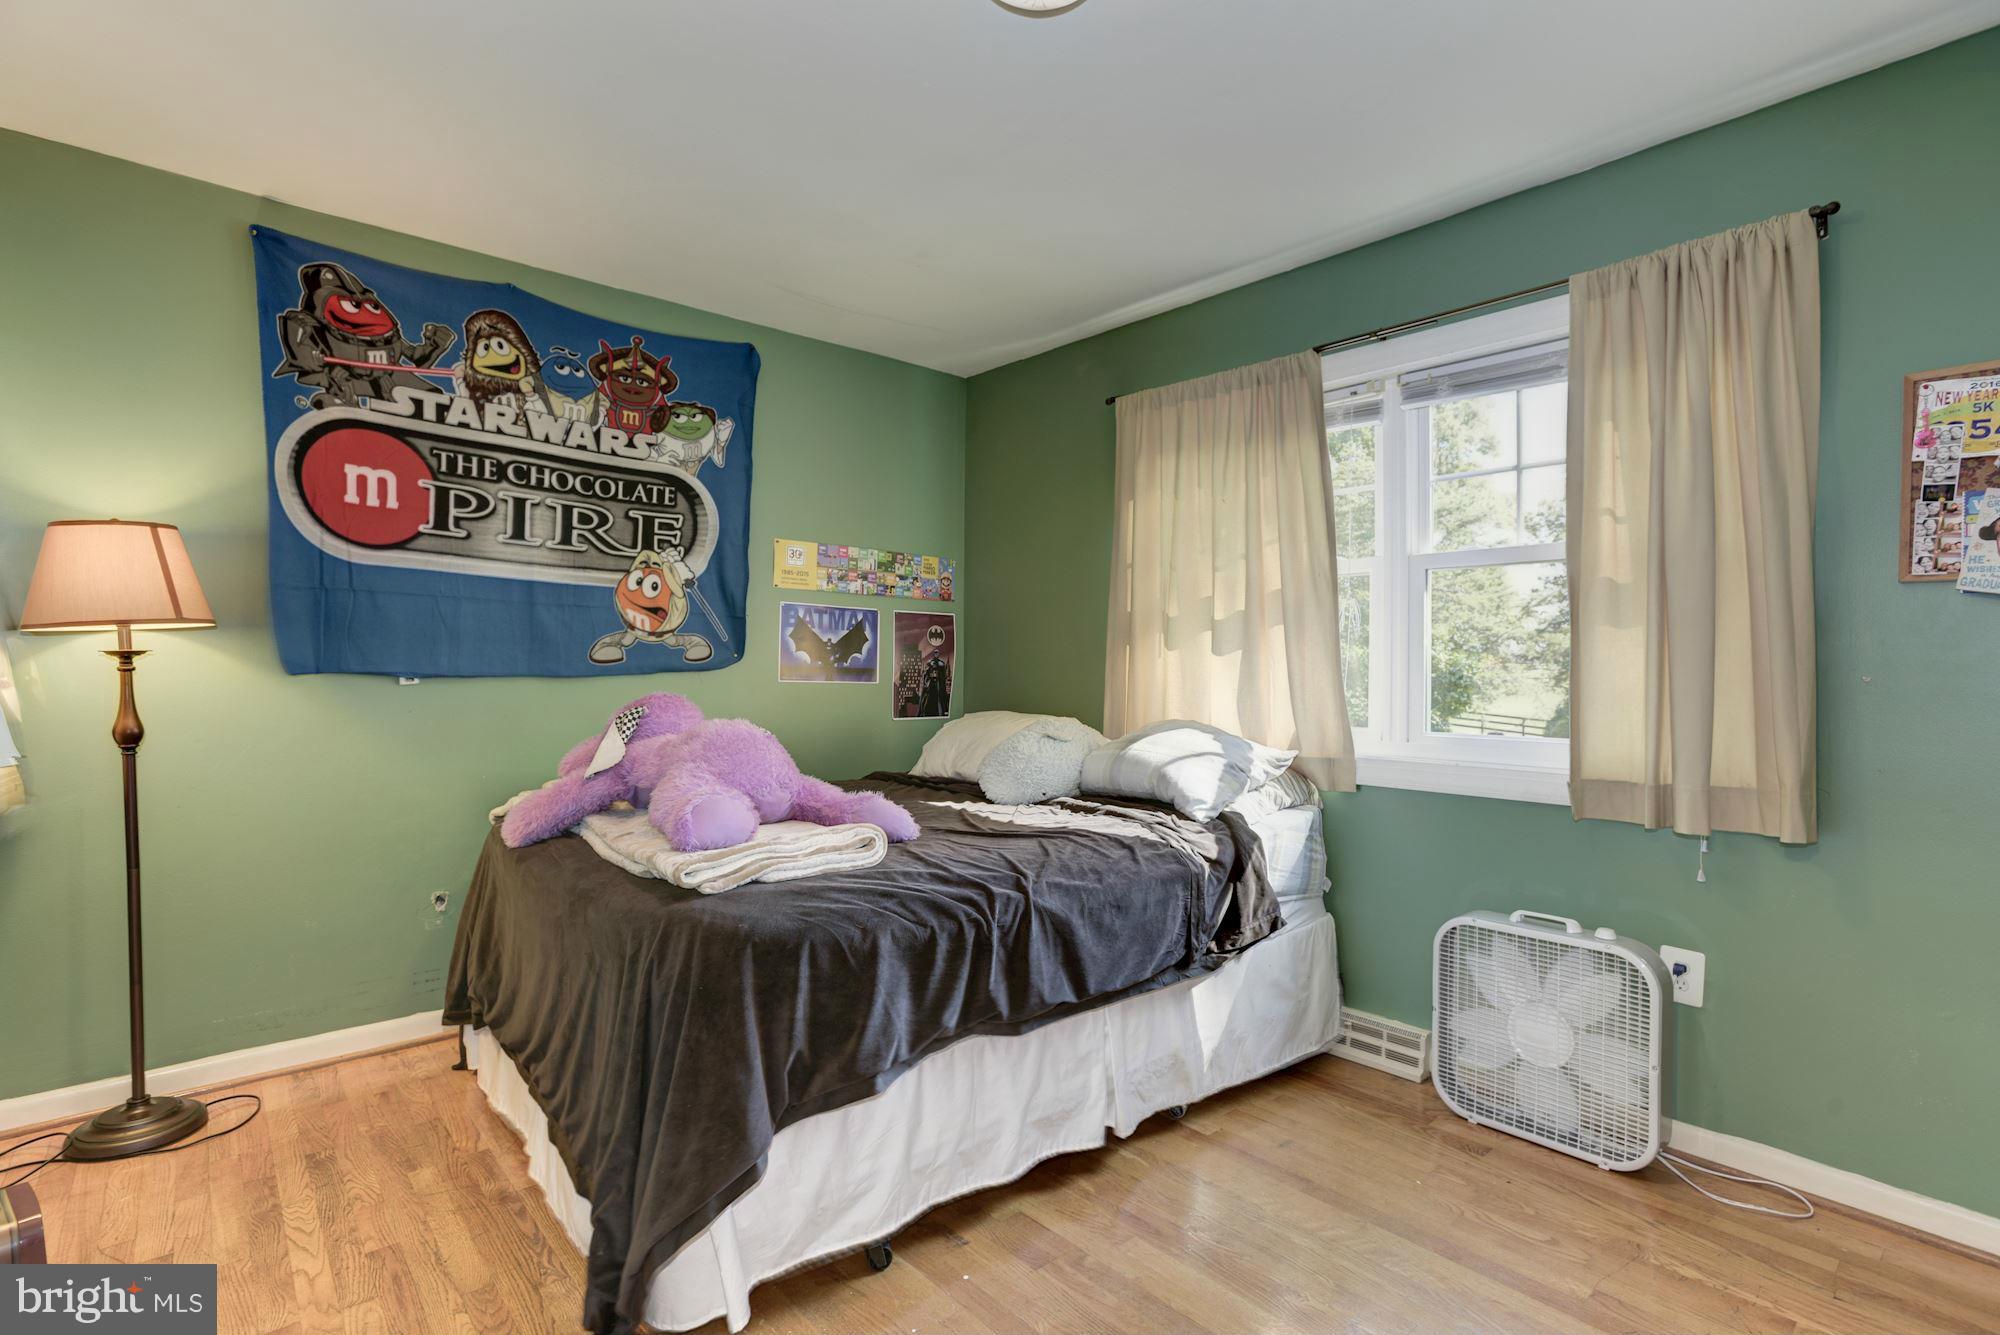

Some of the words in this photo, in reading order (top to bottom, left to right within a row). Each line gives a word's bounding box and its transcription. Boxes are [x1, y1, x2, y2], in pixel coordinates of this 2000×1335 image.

[1935, 390, 1964, 407] NEW
[1972, 400, 1994, 413] 5K
[370, 386, 528, 437] STAR
[525, 409, 657, 460] WARS
[621, 410, 641, 426] m
[432, 450, 498, 480] THE
[506, 463, 677, 506] CHOCOLATE
[343, 463, 399, 510] m
[417, 479, 685, 557] PIRE
[1968, 555, 1985, 564] HE
[784, 607, 875, 631] BATMAN
